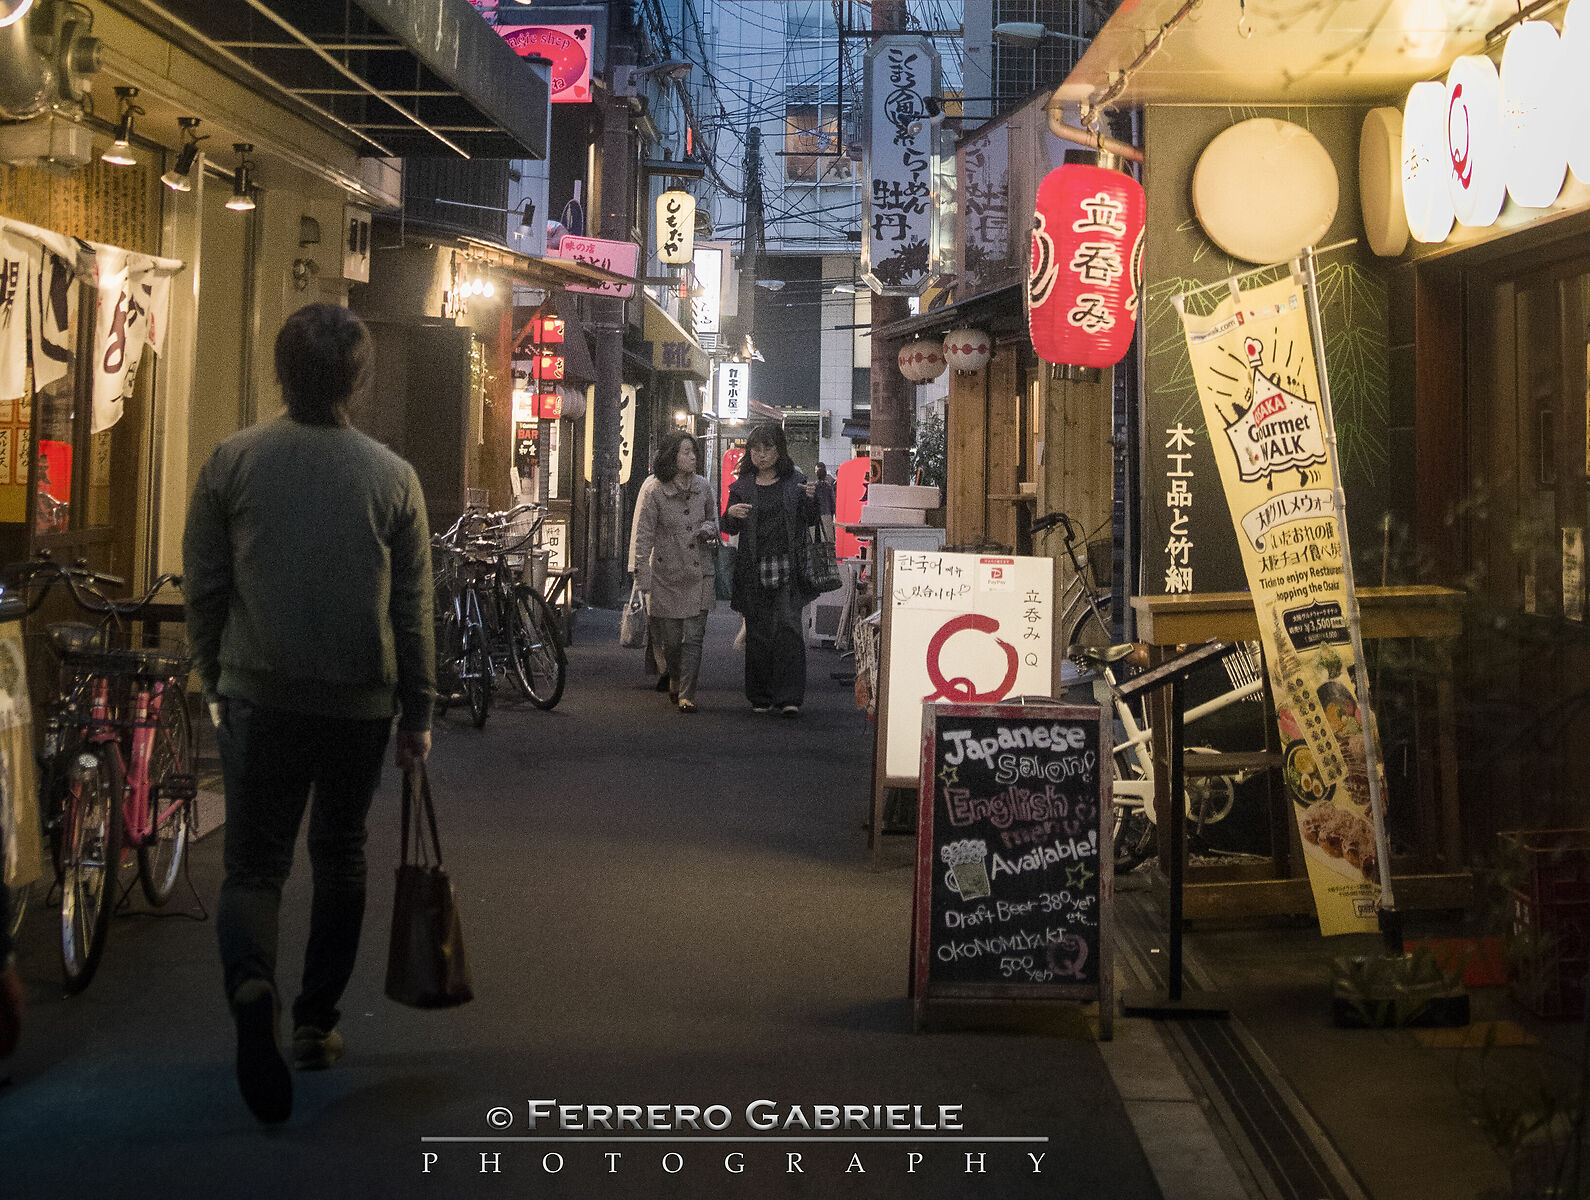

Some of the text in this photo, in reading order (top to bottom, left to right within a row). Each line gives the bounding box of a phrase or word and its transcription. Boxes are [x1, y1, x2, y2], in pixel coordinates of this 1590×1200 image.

[508, 31, 571, 49] agic shop
[903, 148, 930, 214] らーめん
[871, 179, 911, 240] 牡丹
[664, 199, 684, 256] しもたや
[565, 240, 595, 254] 味の店
[1068, 193, 1126, 332] 立呑み
[728, 368, 739, 408] カキ小屋
[518, 429, 538, 439] BAR
[1248, 415, 1310, 443] Gourmet
[1260, 435, 1305, 462] WALK
[898, 555, 943, 575] 한국어
[1287, 571, 1308, 586] enjoy
[1309, 582, 1322, 593] the
[1023, 590, 1042, 667] 立呑み Q
[943, 726, 1086, 769] Japanese
[995, 751, 1095, 784] Salon!
[944, 785, 1068, 828] English
[992, 830, 1097, 880] Available!
[945, 905, 996, 929] Draft
[996, 901, 1037, 921] Beer
[1039, 891, 1070, 912] 380
[1000, 956, 1033, 978] 500
[1025, 969, 1053, 982] yen
